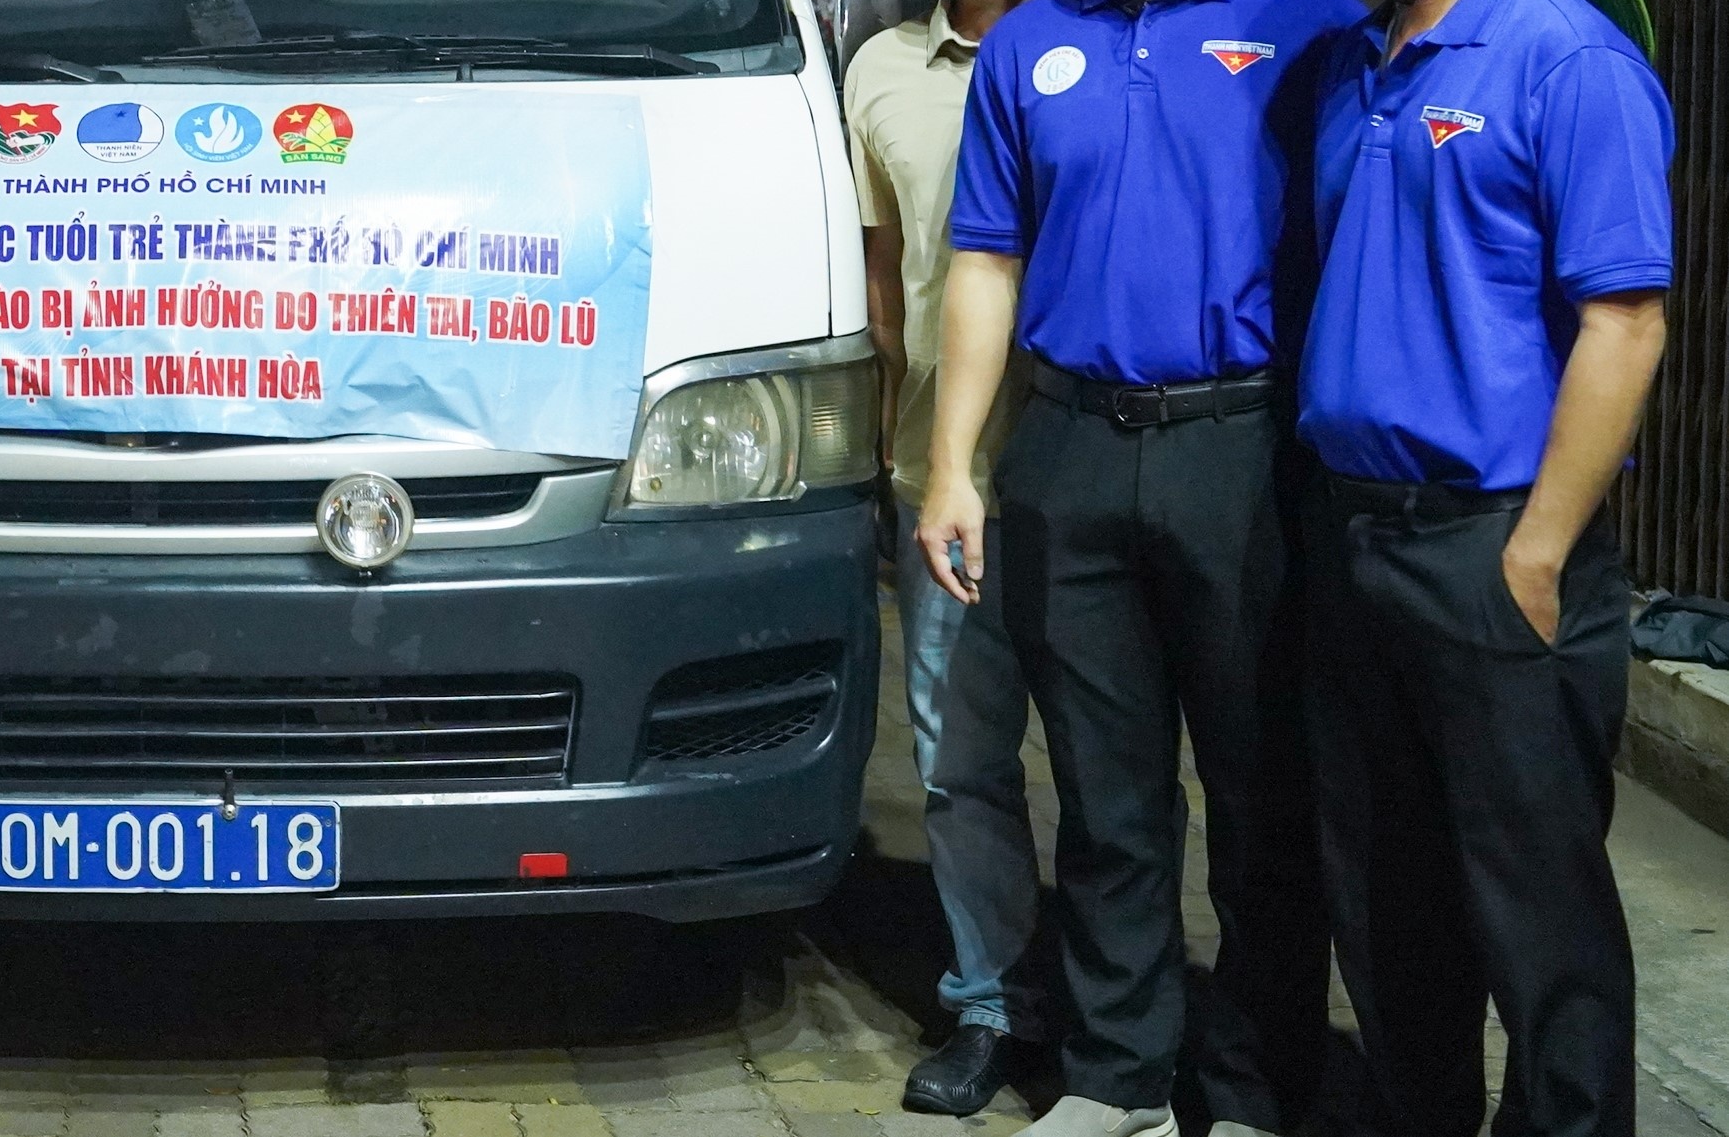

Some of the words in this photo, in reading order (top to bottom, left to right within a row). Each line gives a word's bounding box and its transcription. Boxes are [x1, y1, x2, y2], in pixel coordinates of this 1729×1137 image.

[3, 174, 87, 194] THÀNH
[97, 171, 151, 194] PHỐ
[159, 170, 197, 194] HỒ
[206, 174, 253, 194] CHÍ
[261, 178, 326, 195] MINH
[26, 211, 97, 262] TUỔI
[108, 215, 163, 261] TRẺ
[174, 219, 276, 262] THÀNH
[479, 232, 560, 276] MINH
[42, 289, 73, 336] BỊ
[83, 280, 146, 328] ẢNH
[157, 280, 264, 330] HƯỞNG
[275, 290, 318, 331] DO
[328, 287, 416, 334] THIÊN
[488, 295, 550, 343] BÃO
[561, 300, 596, 346] LŨ
[1, 357, 51, 403] TẠI
[61, 347, 133, 397] TỈNH
[145, 350, 247, 398] KHÁNH
[258, 353, 322, 400] HÒA
